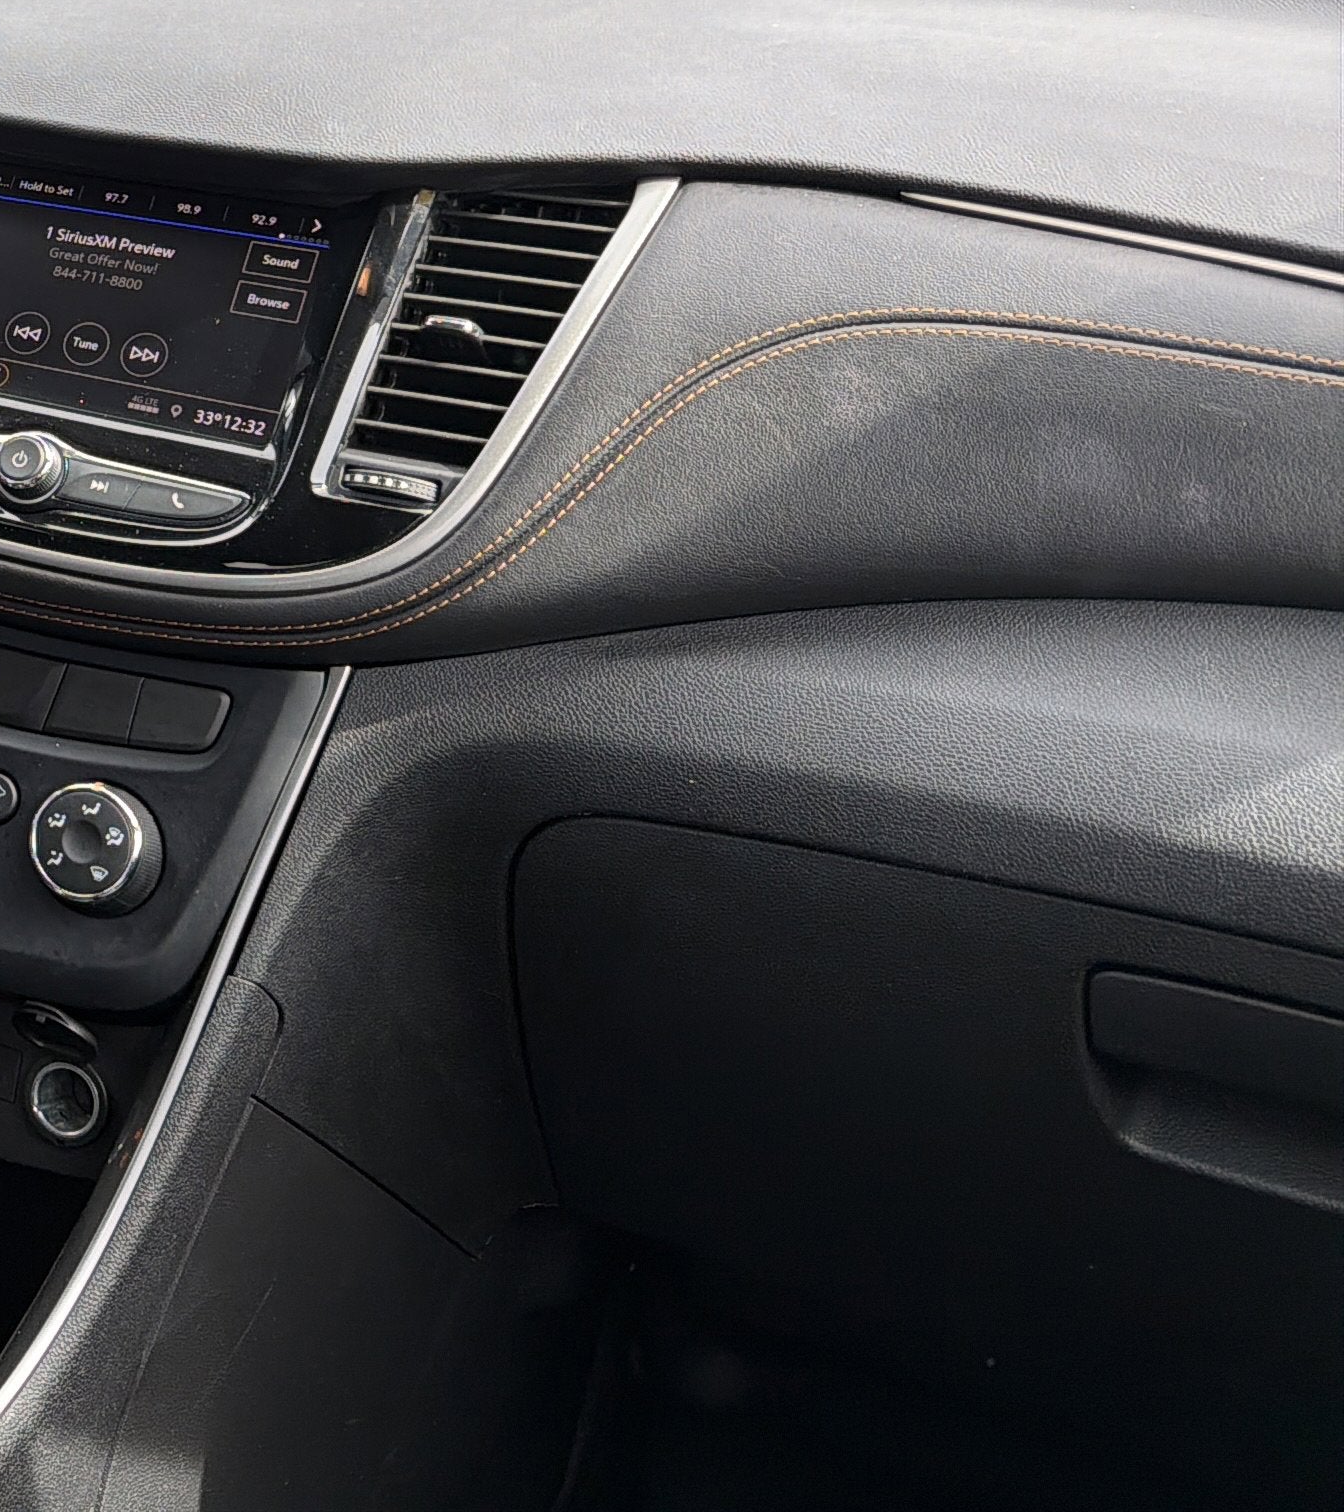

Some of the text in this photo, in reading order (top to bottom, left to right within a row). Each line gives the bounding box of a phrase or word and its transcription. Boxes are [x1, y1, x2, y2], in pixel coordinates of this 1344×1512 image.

[18, 180, 75, 197] Hold to Set
[104, 192, 129, 204] 97.7
[176, 203, 202, 215] 98.9
[251, 213, 278, 226] 92.9
[46, 226, 176, 259] 1 SiriusXM Preview
[49, 247, 160, 275] Great Offer Now!
[262, 254, 300, 270] Sound
[52, 265, 143, 292] 844-711-8800
[246, 293, 290, 310] Browse
[72, 336, 99, 351] Tune
[131, 394, 160, 407] 4G LTE
